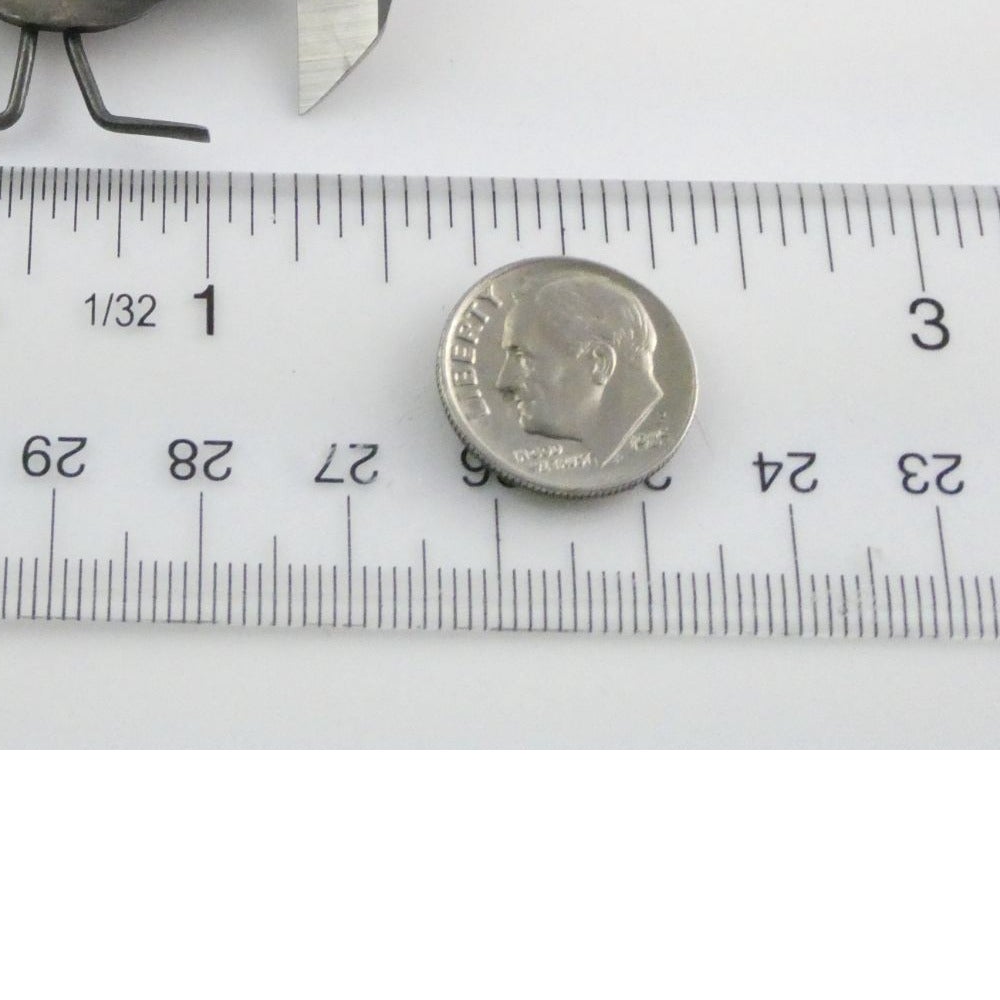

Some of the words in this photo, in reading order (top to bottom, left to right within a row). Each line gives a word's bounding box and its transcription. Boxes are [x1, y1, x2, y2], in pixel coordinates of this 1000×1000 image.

[84, 292, 157, 328] 1/32
[193, 284, 215, 336] 1
[908, 297, 950, 351] 3
[450, 283, 504, 417] LIBERTY
[21, 435, 88, 478] 29
[167, 438, 234, 482] 28
[314, 443, 379, 485] 27
[752, 451, 819, 494] 24
[897, 452, 965, 496] 23
